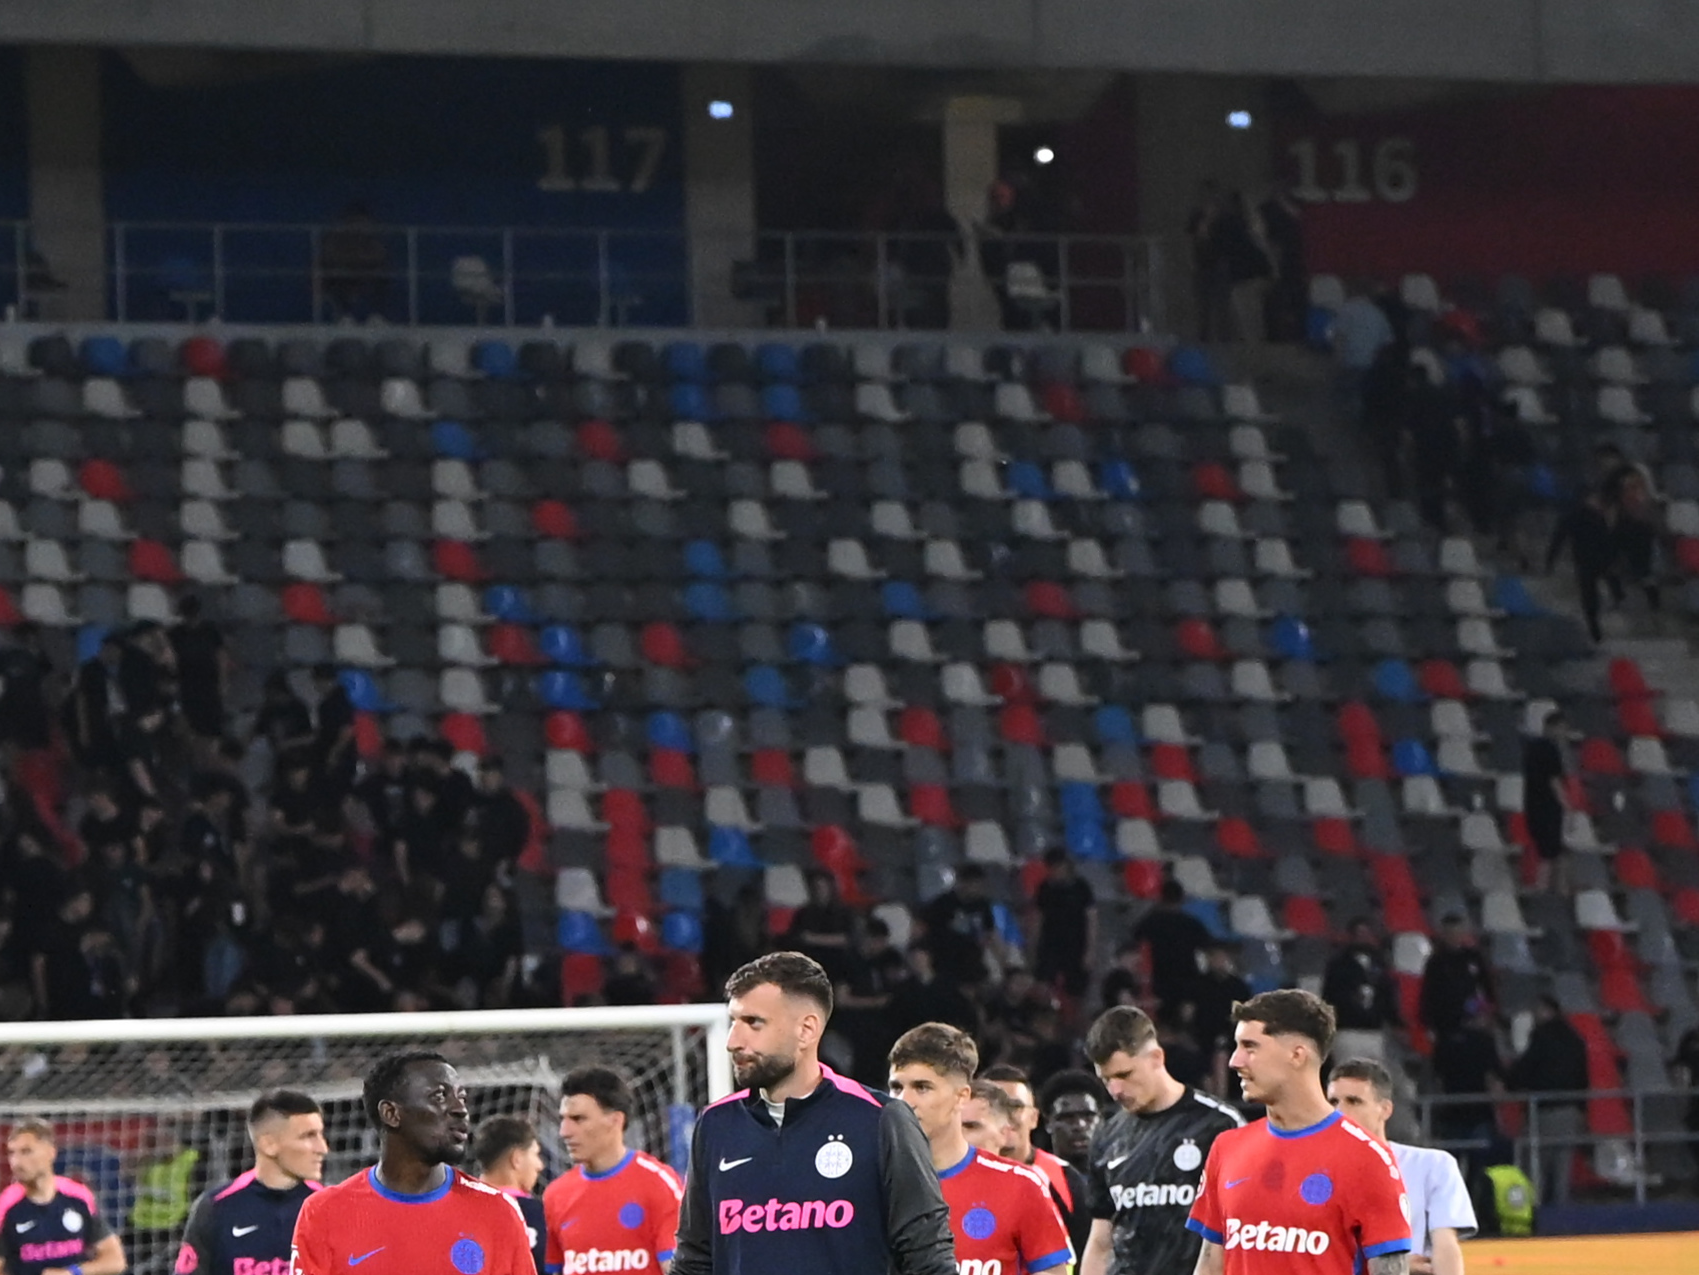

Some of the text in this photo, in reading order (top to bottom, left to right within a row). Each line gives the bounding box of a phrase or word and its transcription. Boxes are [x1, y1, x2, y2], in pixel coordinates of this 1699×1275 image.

[534, 124, 668, 195] 117
[1286, 136, 1418, 204] 116
[719, 1198, 854, 1234] Betano
[1224, 1218, 1329, 1256] Betano
